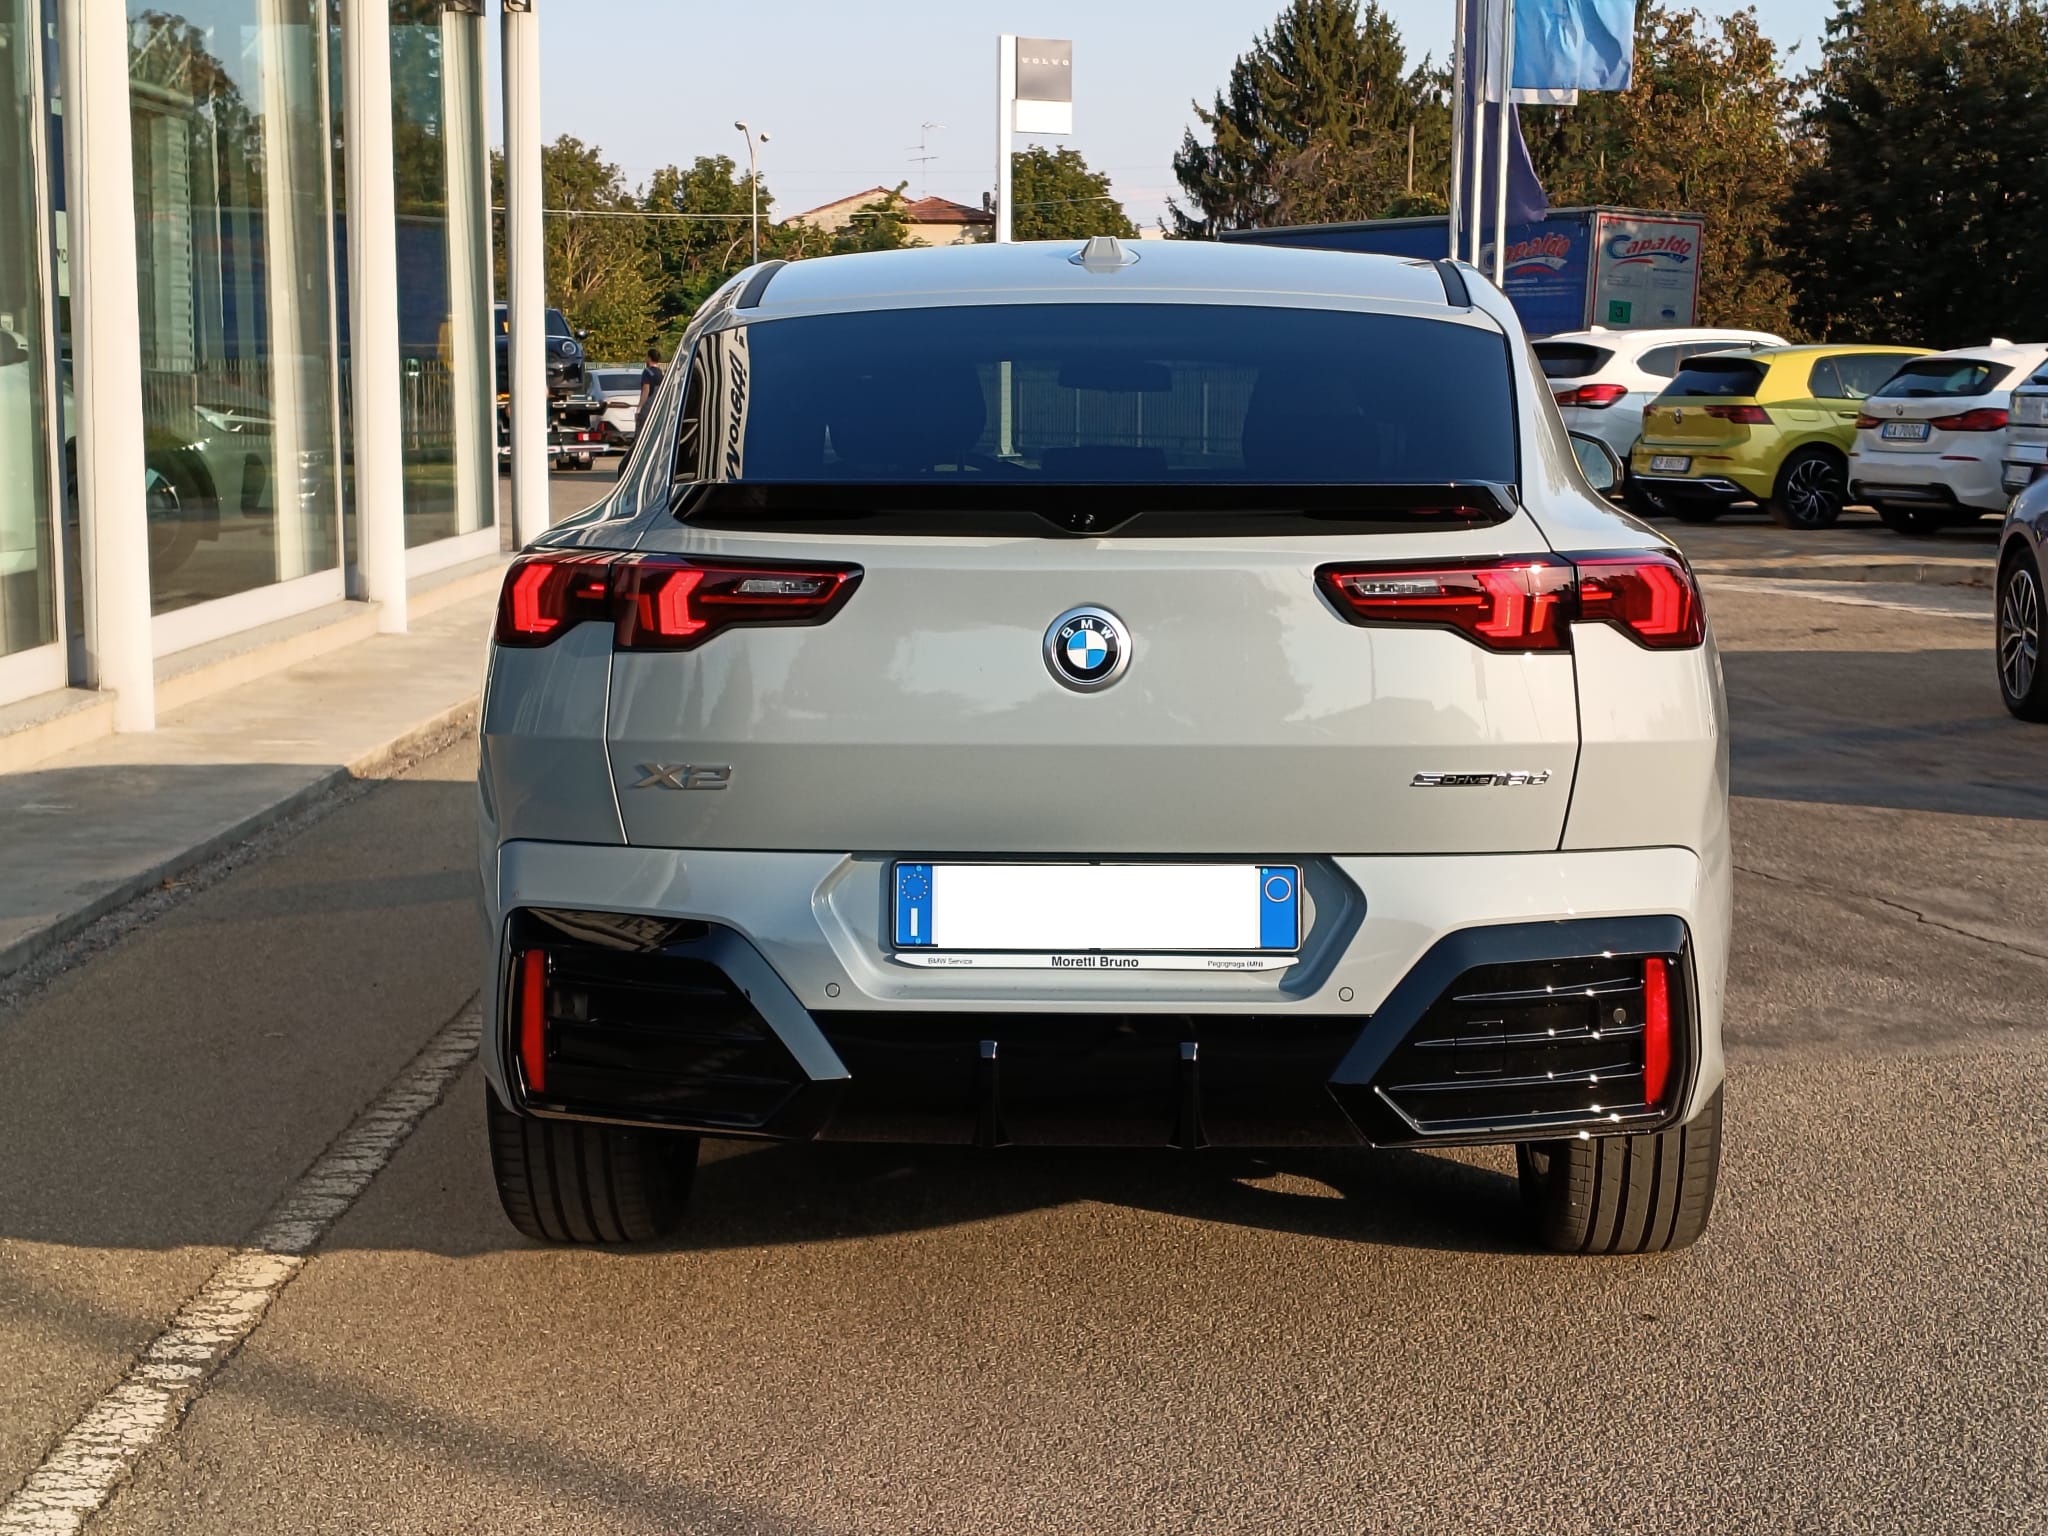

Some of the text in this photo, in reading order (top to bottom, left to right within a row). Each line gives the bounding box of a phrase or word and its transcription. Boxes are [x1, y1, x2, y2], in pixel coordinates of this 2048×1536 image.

[1021, 56, 1070, 67] VOLVO
[1606, 234, 1692, 259] Capaldo
[1061, 619, 1114, 640] BMW
[632, 762, 732, 790] X2
[1051, 956, 1139, 968] Moretti Bruno
